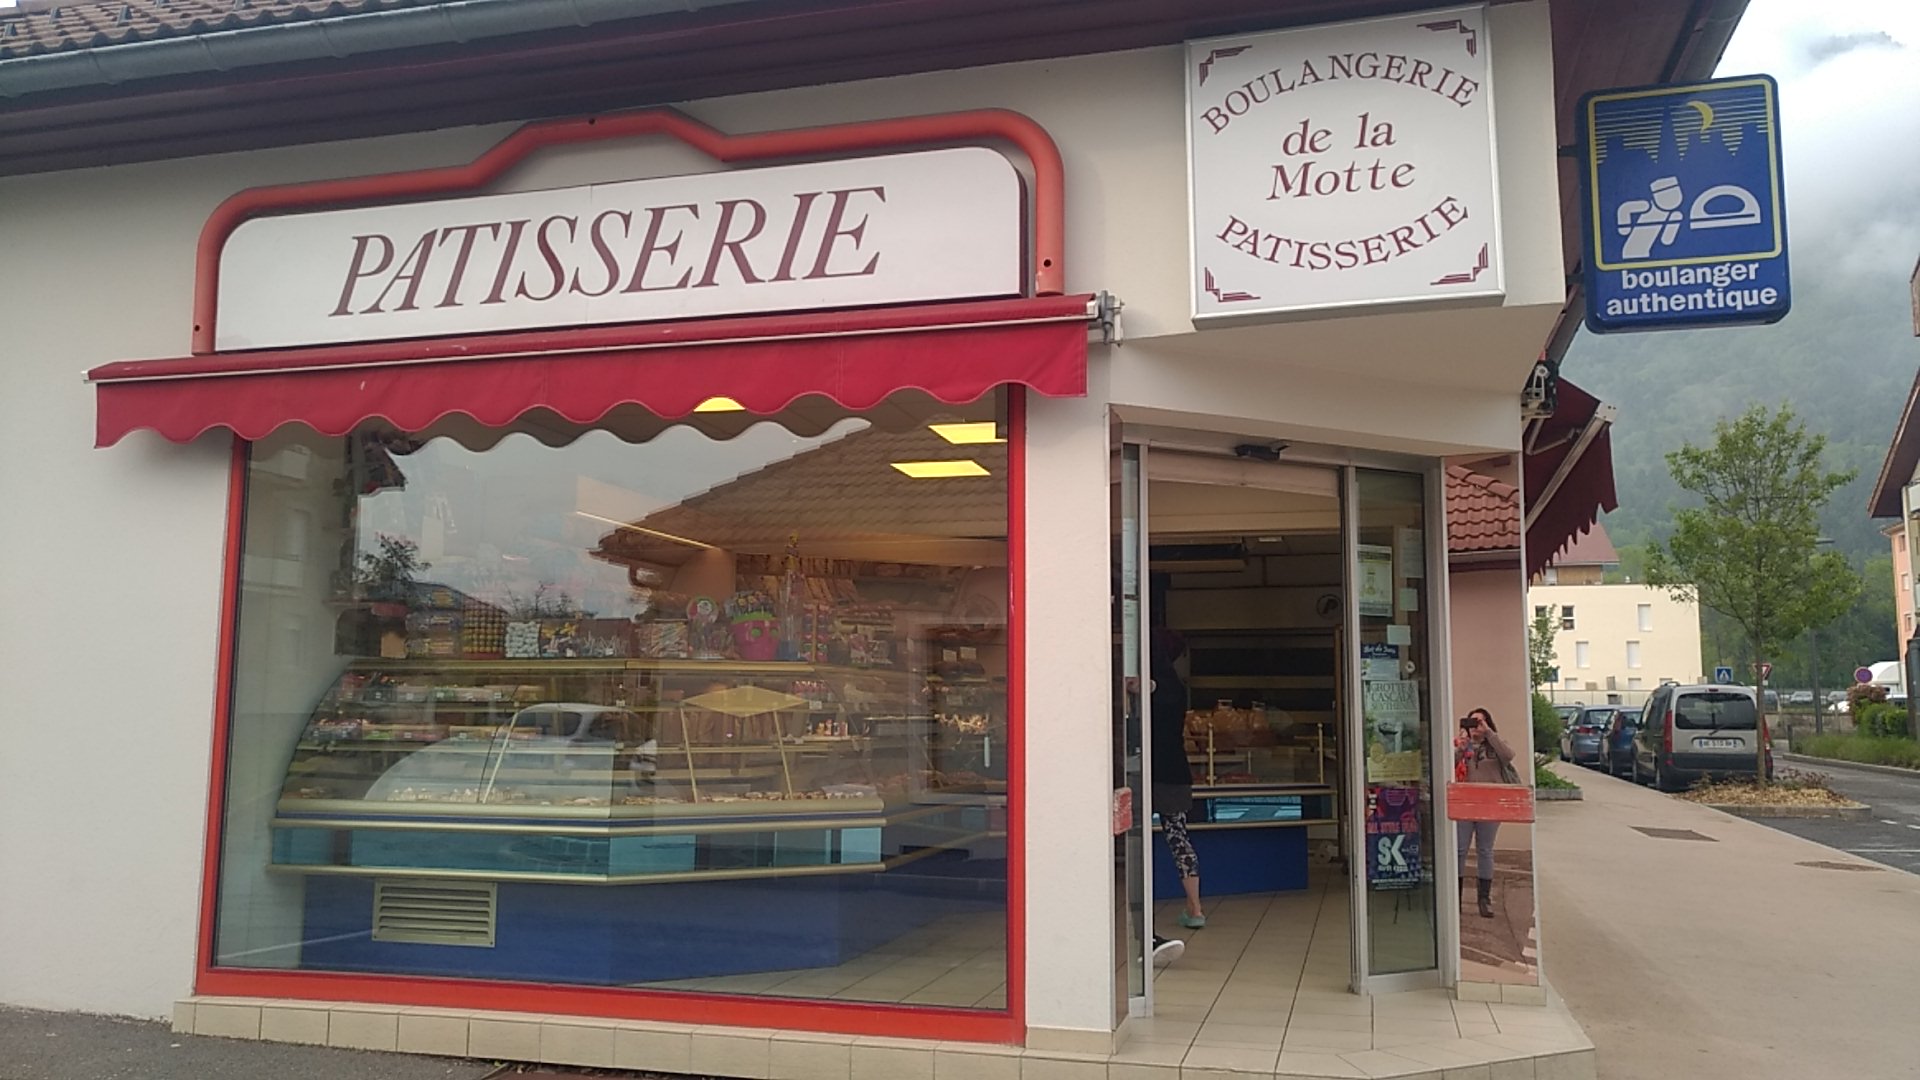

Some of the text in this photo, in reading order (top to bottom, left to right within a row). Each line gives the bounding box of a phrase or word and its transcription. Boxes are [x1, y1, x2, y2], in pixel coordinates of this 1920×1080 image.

[1201, 52, 1479, 134] BOULANGERIE
[1282, 112, 1396, 156] de la
[1266, 158, 1415, 200] Motte
[328, 186, 887, 317] PATISSERIE
[1216, 196, 1469, 270] PATISSERIE
[1622, 262, 1759, 289] boulanger
[1606, 287, 1777, 316] authentique
[1378, 834, 1408, 866] SK
